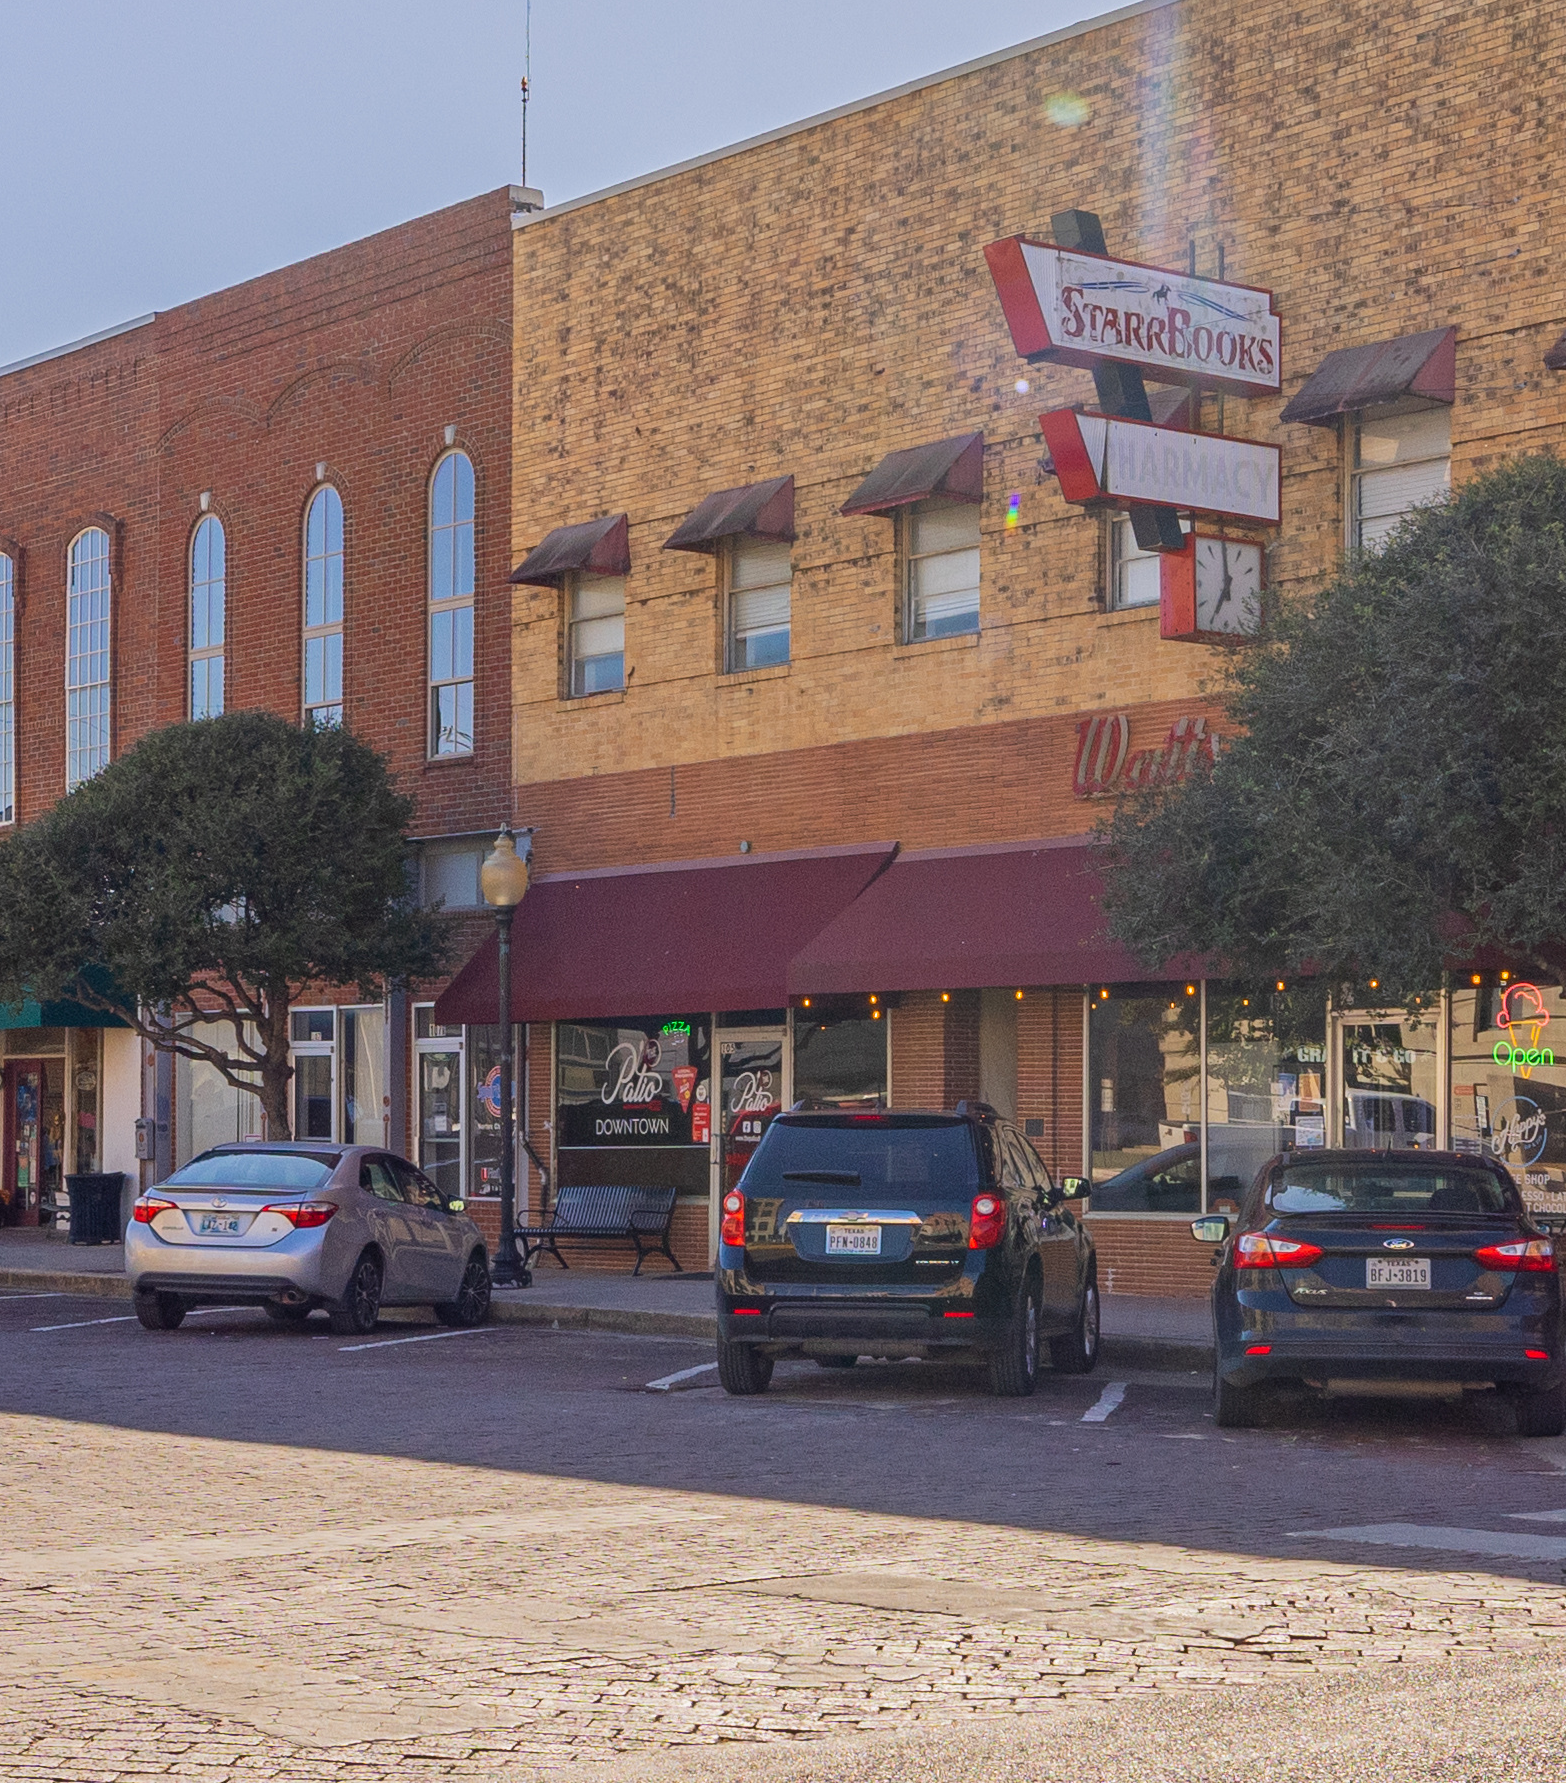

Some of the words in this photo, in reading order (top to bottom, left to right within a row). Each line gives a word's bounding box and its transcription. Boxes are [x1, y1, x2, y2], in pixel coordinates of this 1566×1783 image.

[1393, 1047, 1417, 1064] GO
[1492, 1040, 1555, 1074] Open
[601, 1039, 664, 1105] Patio
[730, 1070, 773, 1113] Patio
[595, 1118, 670, 1136] DOWNTOWN
[1491, 1108, 1547, 1155] Happy's
[1524, 1174, 1550, 1185] SHOP
[1521, 1192, 1546, 1202] ESSO
